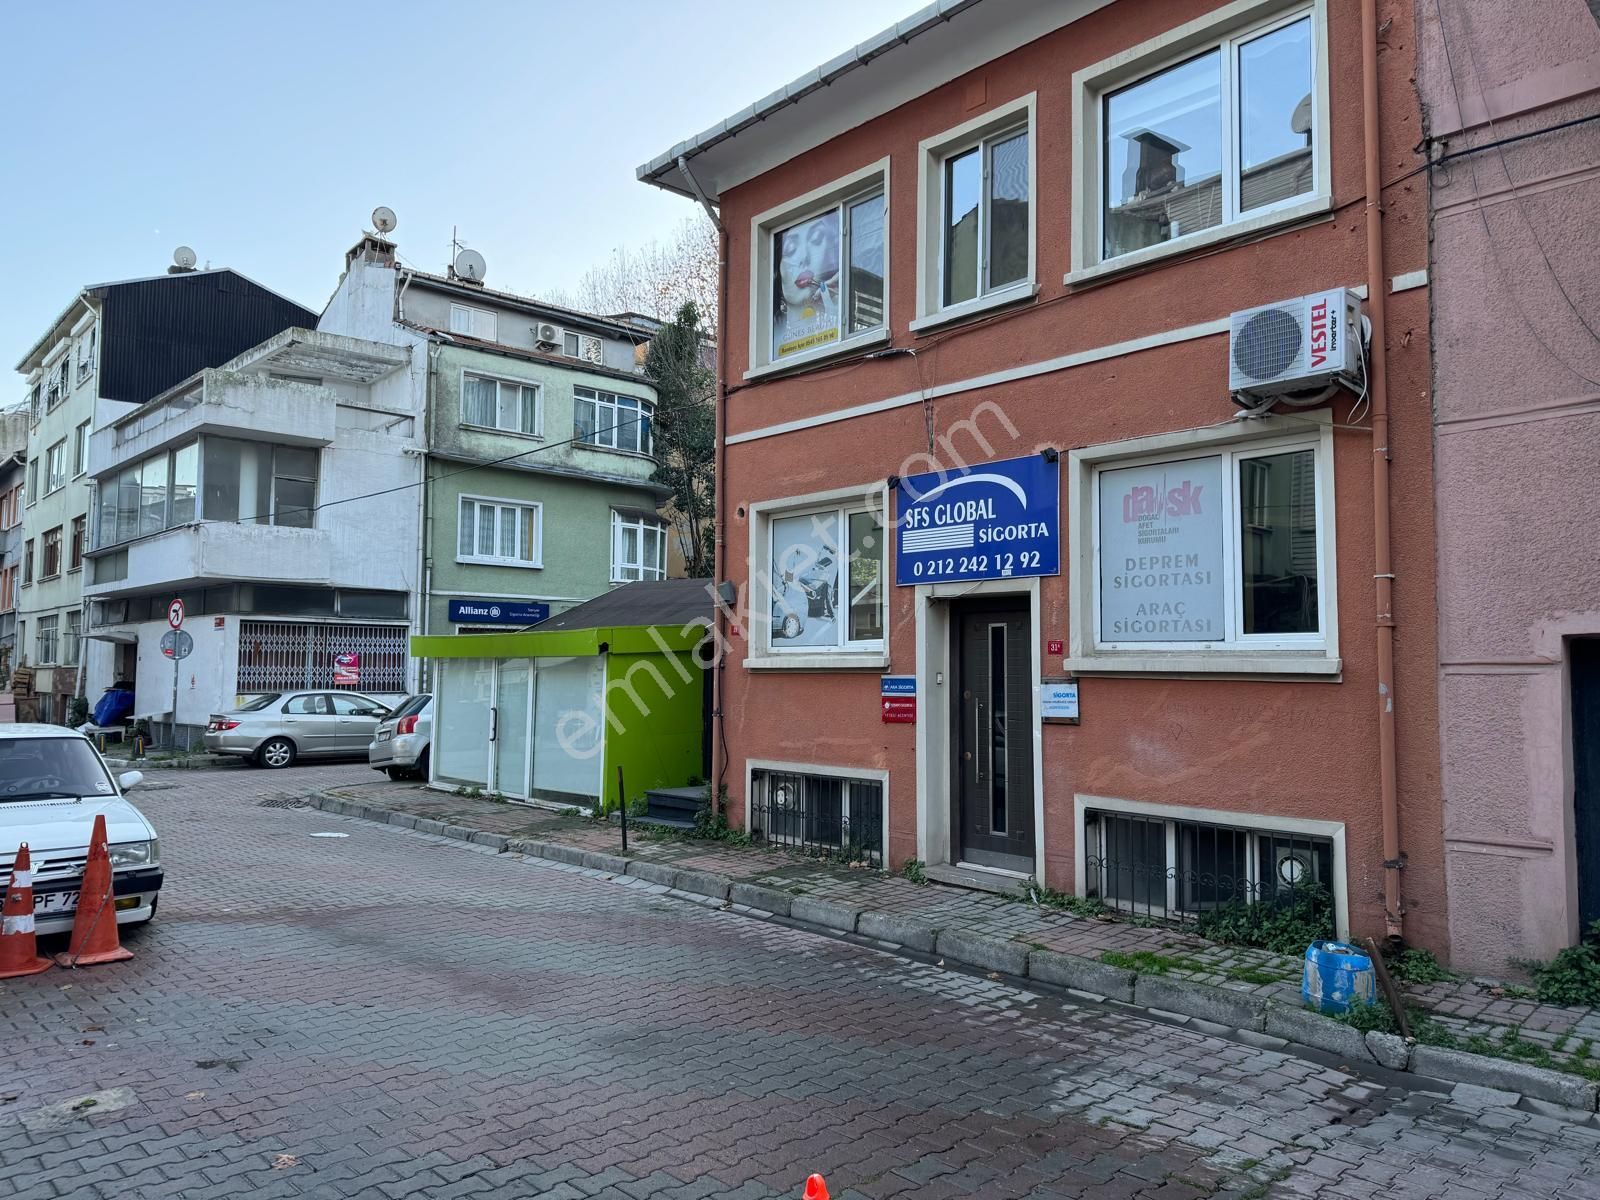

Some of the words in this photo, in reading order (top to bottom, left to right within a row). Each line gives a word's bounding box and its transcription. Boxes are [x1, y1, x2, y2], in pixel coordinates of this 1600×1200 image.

[1311, 298, 1327, 368] VESTEL
[905, 506, 930, 529] SFS
[934, 498, 996, 526] GLOBAL
[913, 561, 923, 576] 0
[927, 558, 954, 575] 212
[959, 555, 988, 573] 242
[994, 553, 1014, 570] 12
[1020, 551, 1041, 568] 92
[1125, 553, 1199, 571] DEPREM
[1113, 571, 1211, 589] SİGORTASI
[458, 606, 489, 616] Allianz
[1136, 601, 1186, 619] ARAÇ
[1113, 617, 1211, 634] SİGORTASI
